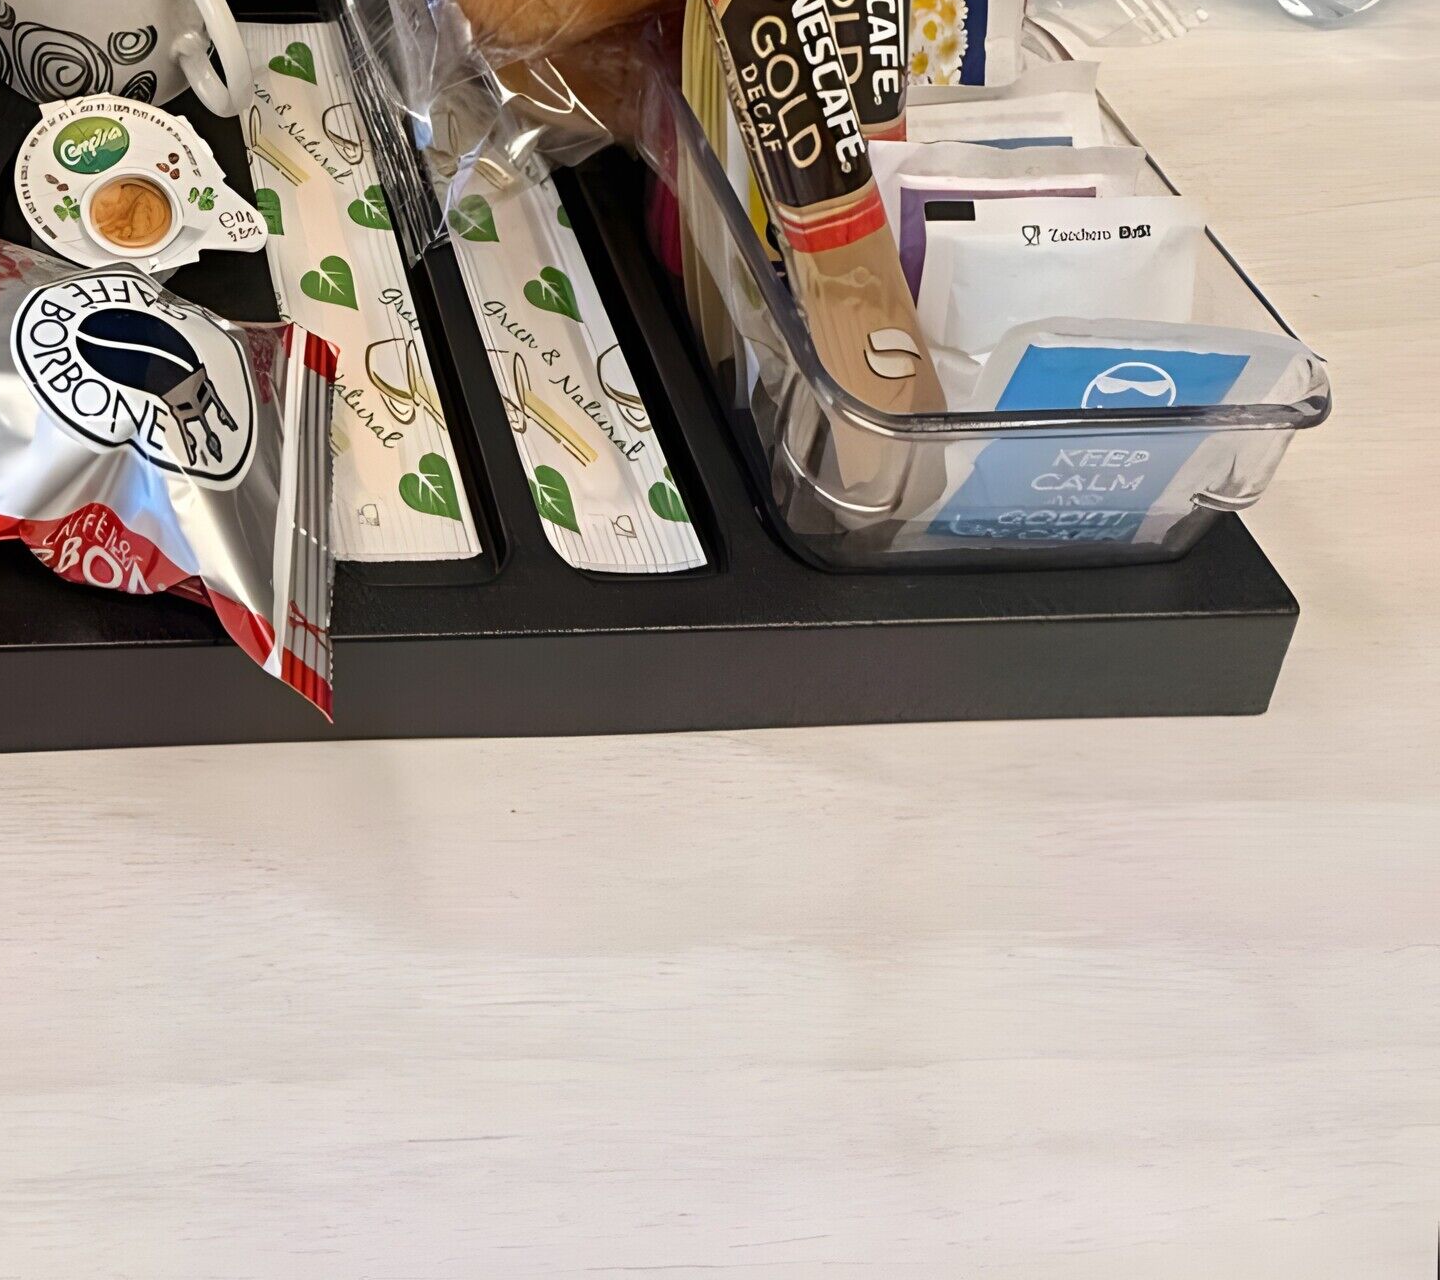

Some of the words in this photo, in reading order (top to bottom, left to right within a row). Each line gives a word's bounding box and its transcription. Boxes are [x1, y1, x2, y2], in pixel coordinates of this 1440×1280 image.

[741, 63, 783, 154] DECAF
[751, 15, 822, 170] GOLD
[29, 298, 168, 450] BORBONE
[549, 374, 645, 462] Natural
[1030, 472, 1145, 491] CALM
[1051, 448, 1151, 468] KEEP
